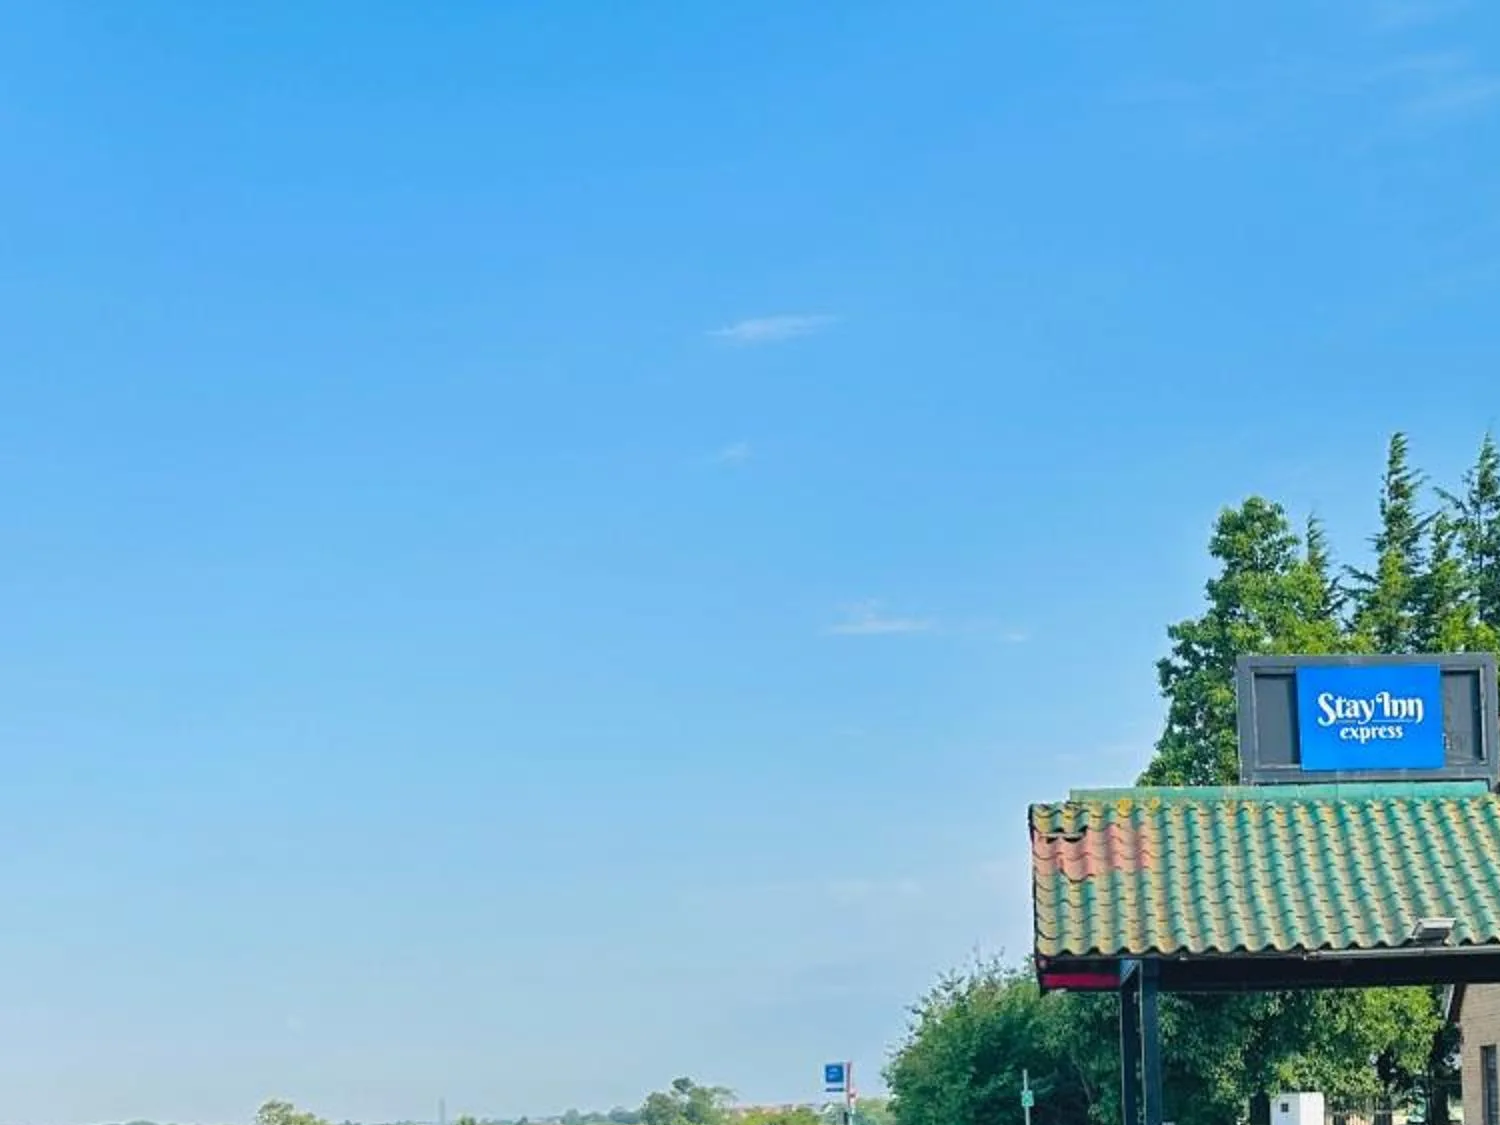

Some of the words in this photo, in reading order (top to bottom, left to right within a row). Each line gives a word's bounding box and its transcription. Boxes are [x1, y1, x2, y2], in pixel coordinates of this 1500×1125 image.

[1317, 692, 1375, 726] Stay
[1375, 690, 1424, 724] Inn
[1339, 725, 1403, 744] express
